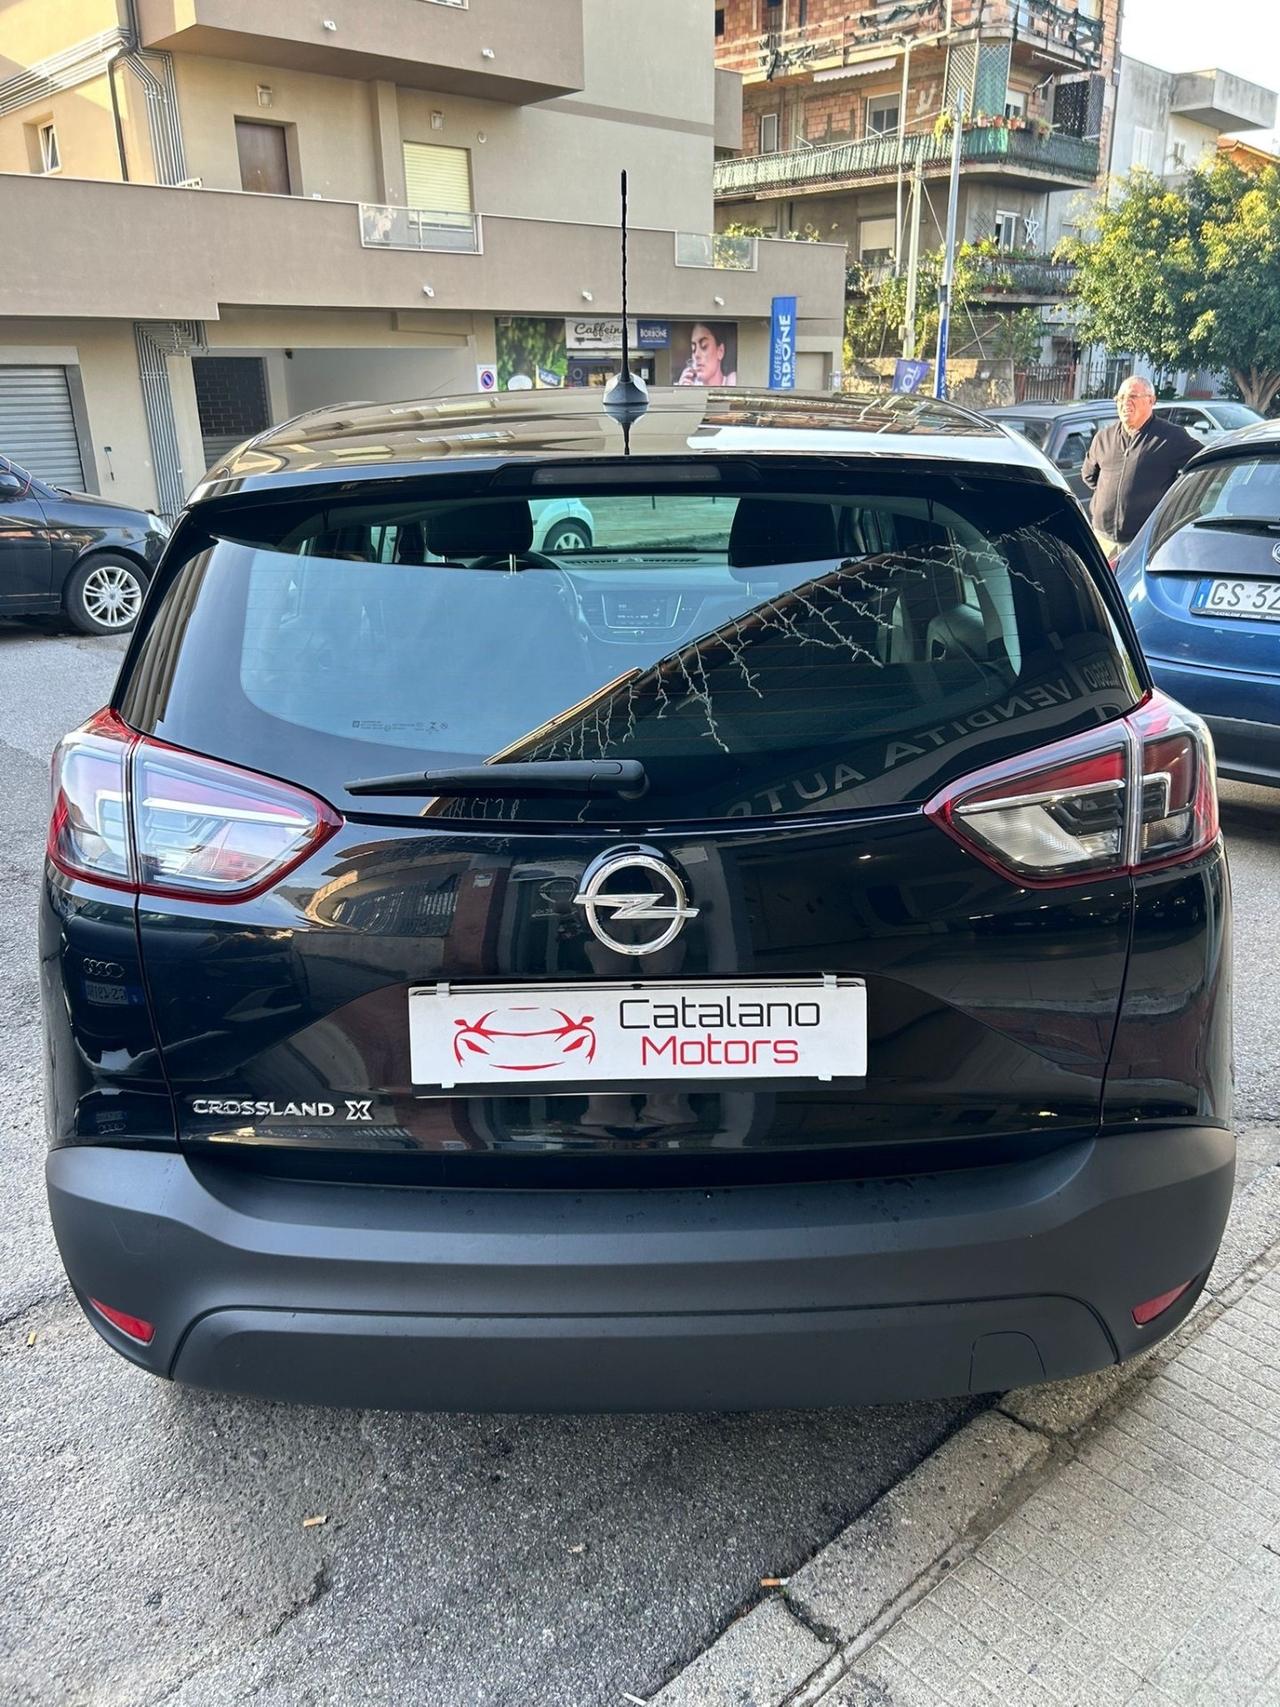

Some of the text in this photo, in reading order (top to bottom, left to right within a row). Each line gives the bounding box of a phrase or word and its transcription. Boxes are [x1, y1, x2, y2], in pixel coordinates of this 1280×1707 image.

[574, 322, 627, 337] Caffein
[619, 996, 820, 1029] Catalano
[642, 1034, 799, 1066] Motors
[192, 1099, 373, 1121] CROSSLAND X
